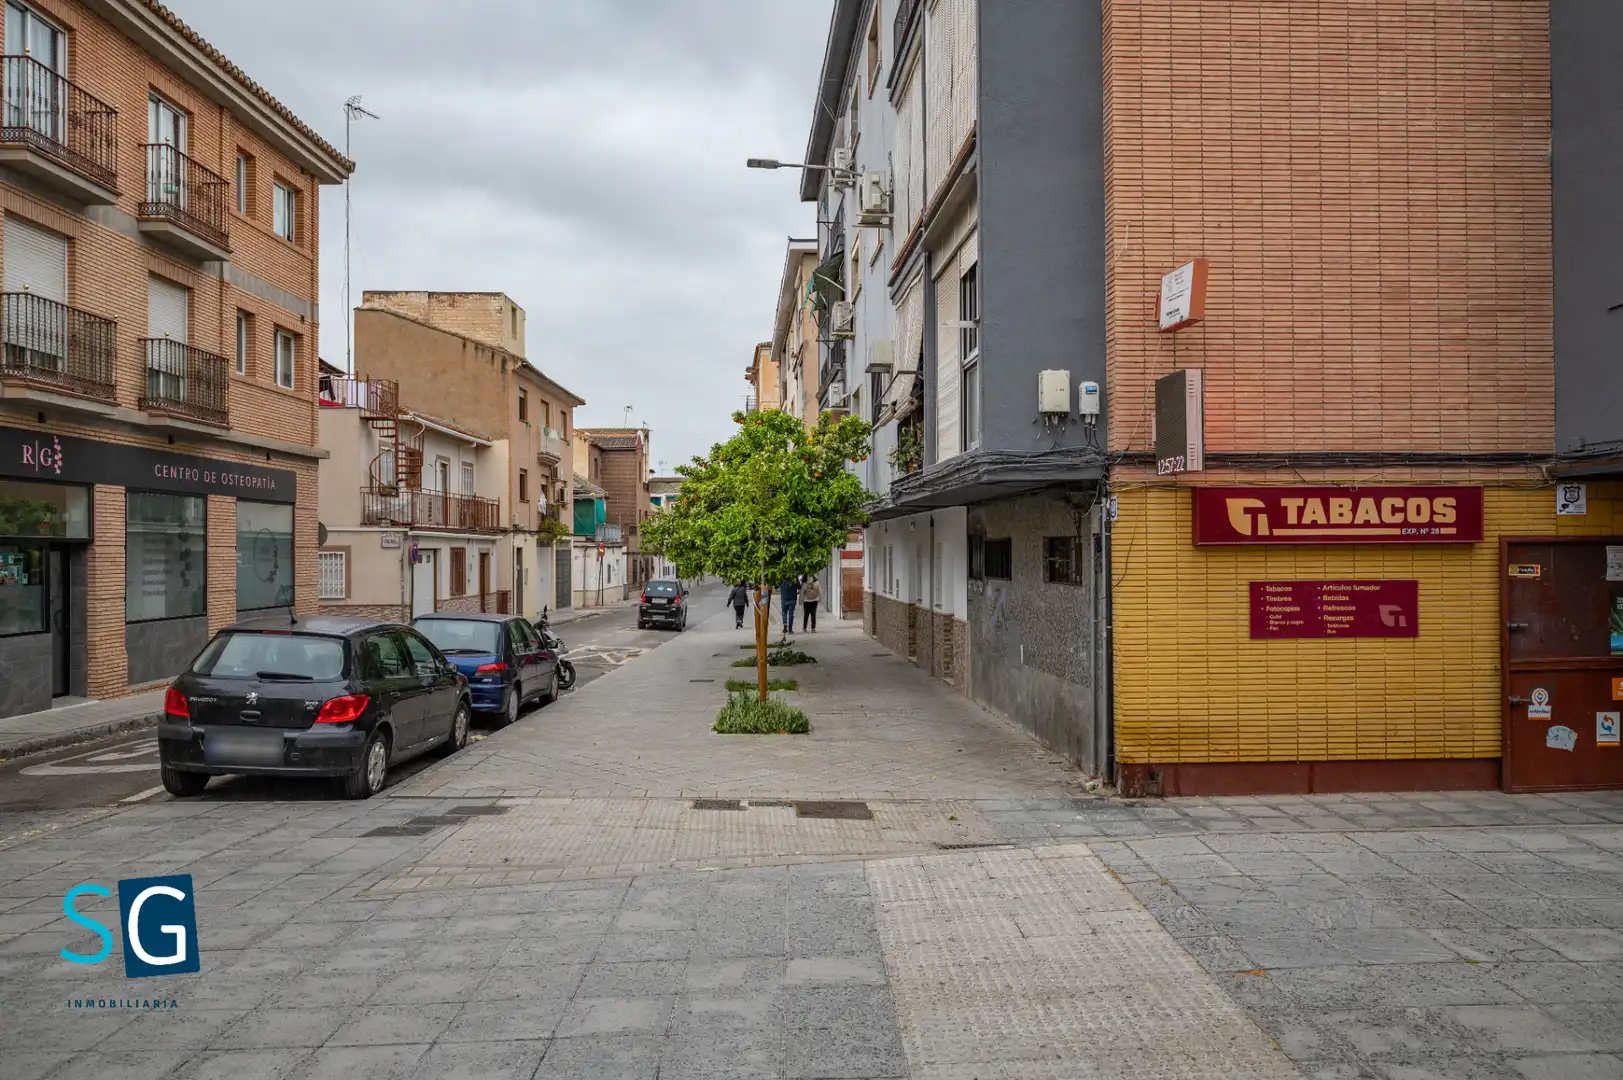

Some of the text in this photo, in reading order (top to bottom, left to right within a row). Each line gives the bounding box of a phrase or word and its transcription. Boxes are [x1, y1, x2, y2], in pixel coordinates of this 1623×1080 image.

[154, 464, 276, 490] CENTRO DE OSTEOPATÍA
[1280, 497, 1457, 525] TABACOS
[1402, 527, 1419, 535] EXP.
[1430, 527, 1440, 535] 28
[1265, 605, 1301, 613] Fotocopias
[1323, 614, 1355, 622] Recargas
